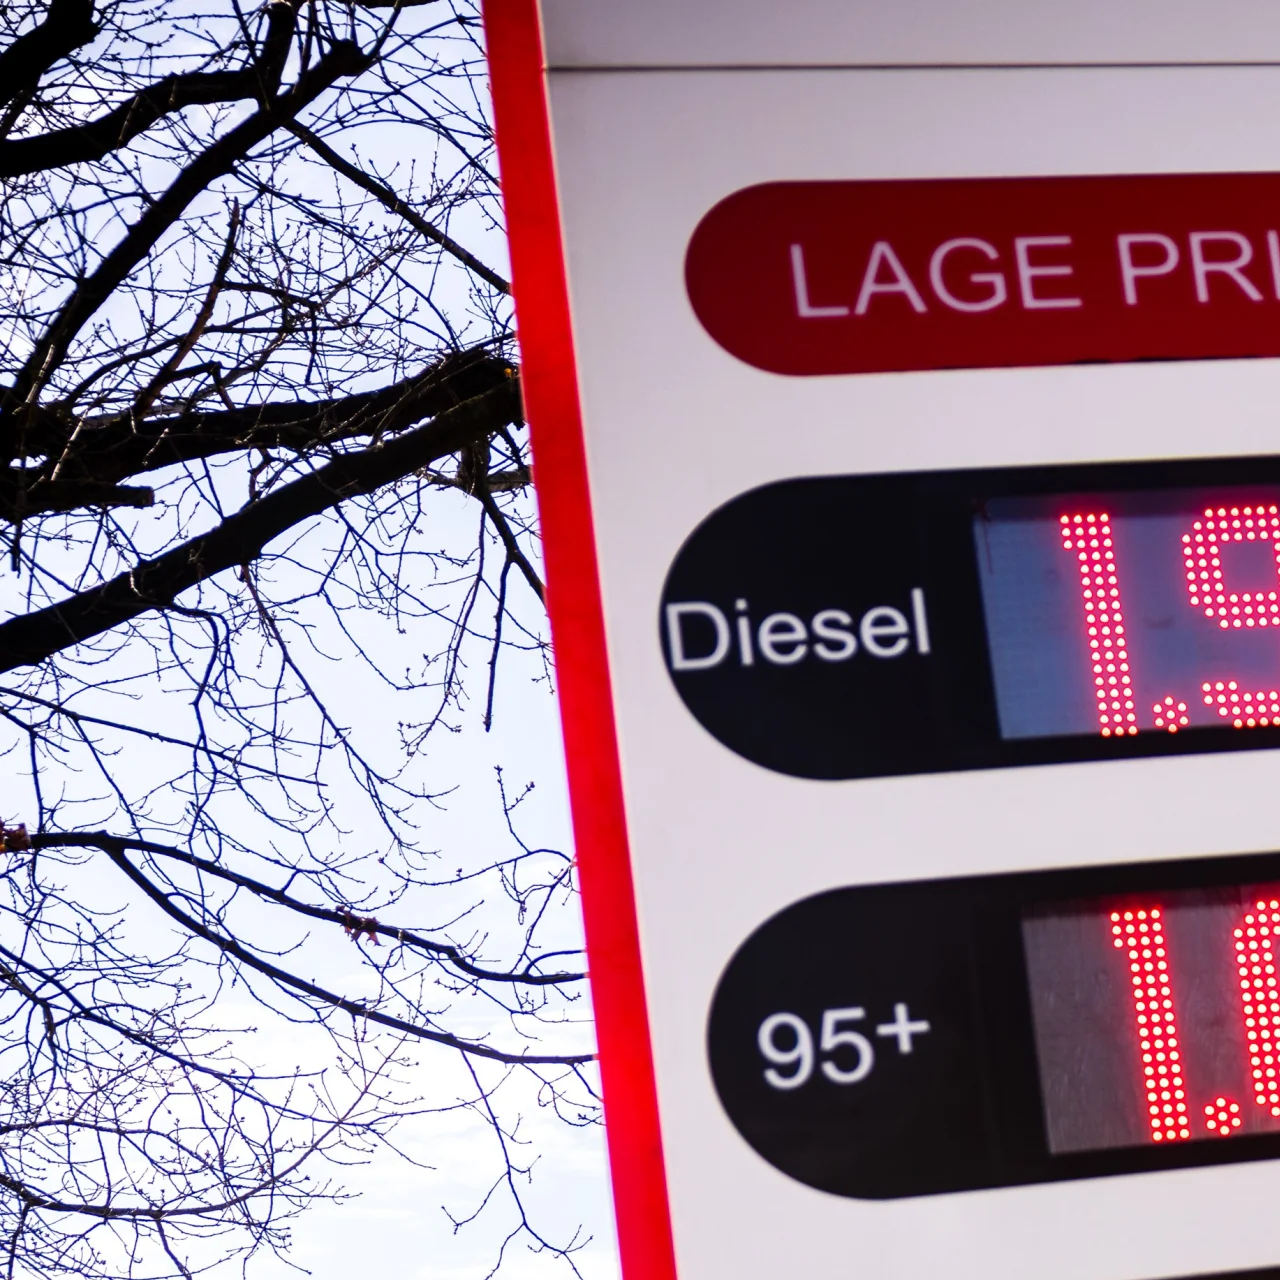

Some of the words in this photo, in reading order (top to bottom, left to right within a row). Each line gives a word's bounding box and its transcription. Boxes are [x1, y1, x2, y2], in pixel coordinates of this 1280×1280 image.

[790, 236, 1083, 318] LAGE
[665, 589, 931, 672] Diesel
[757, 1000, 931, 1090] 95+
